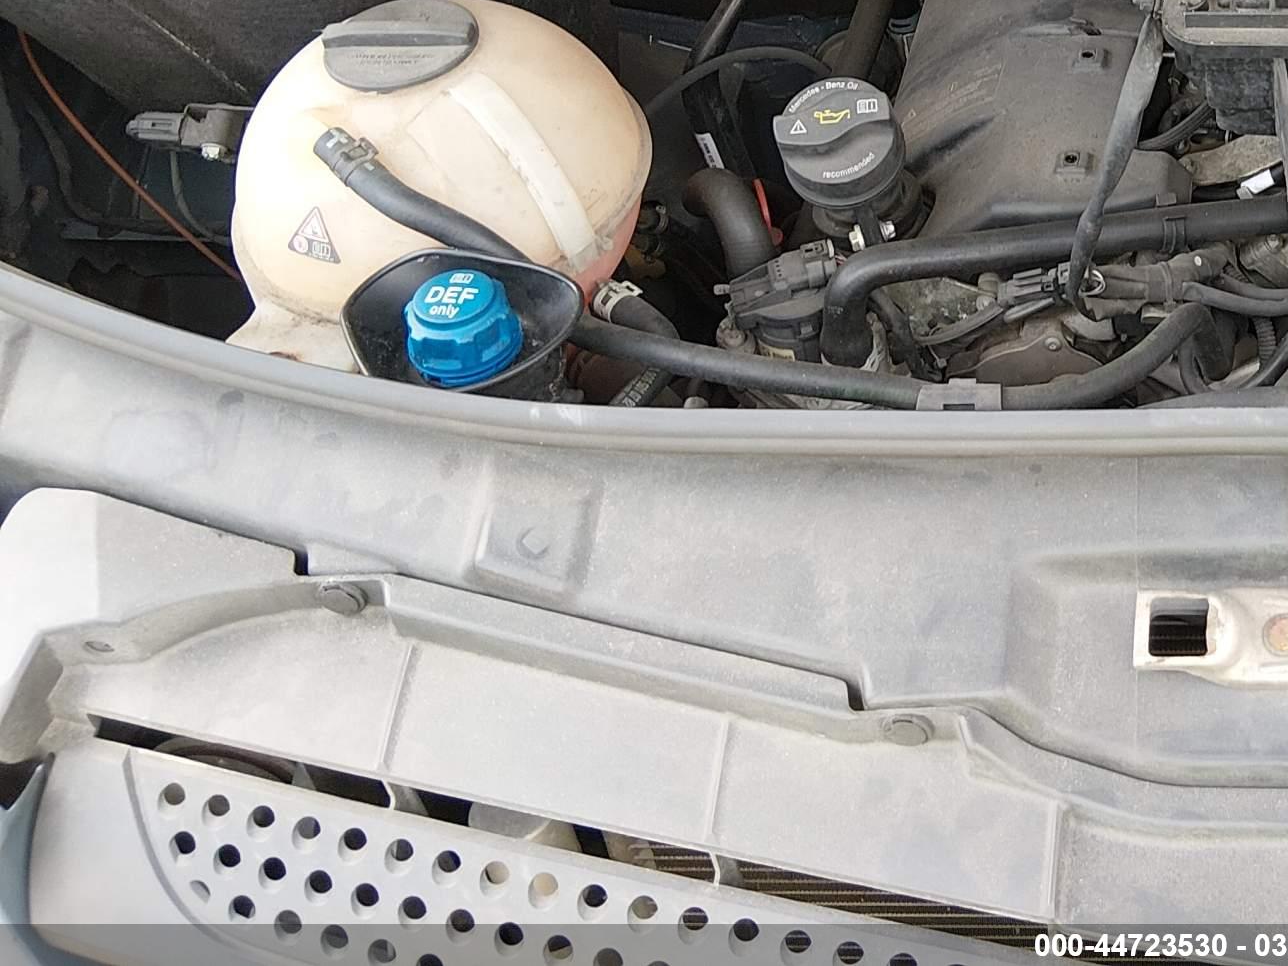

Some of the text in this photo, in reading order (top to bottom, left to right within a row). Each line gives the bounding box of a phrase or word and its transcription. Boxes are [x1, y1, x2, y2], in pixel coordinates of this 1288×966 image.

[789, 85, 820, 113] Mercedes
[825, 81, 845, 91] Benz
[846, 81, 858, 91] Oil
[822, 152, 875, 179] recommended
[424, 286, 479, 304] DEF
[429, 304, 460, 319] only
